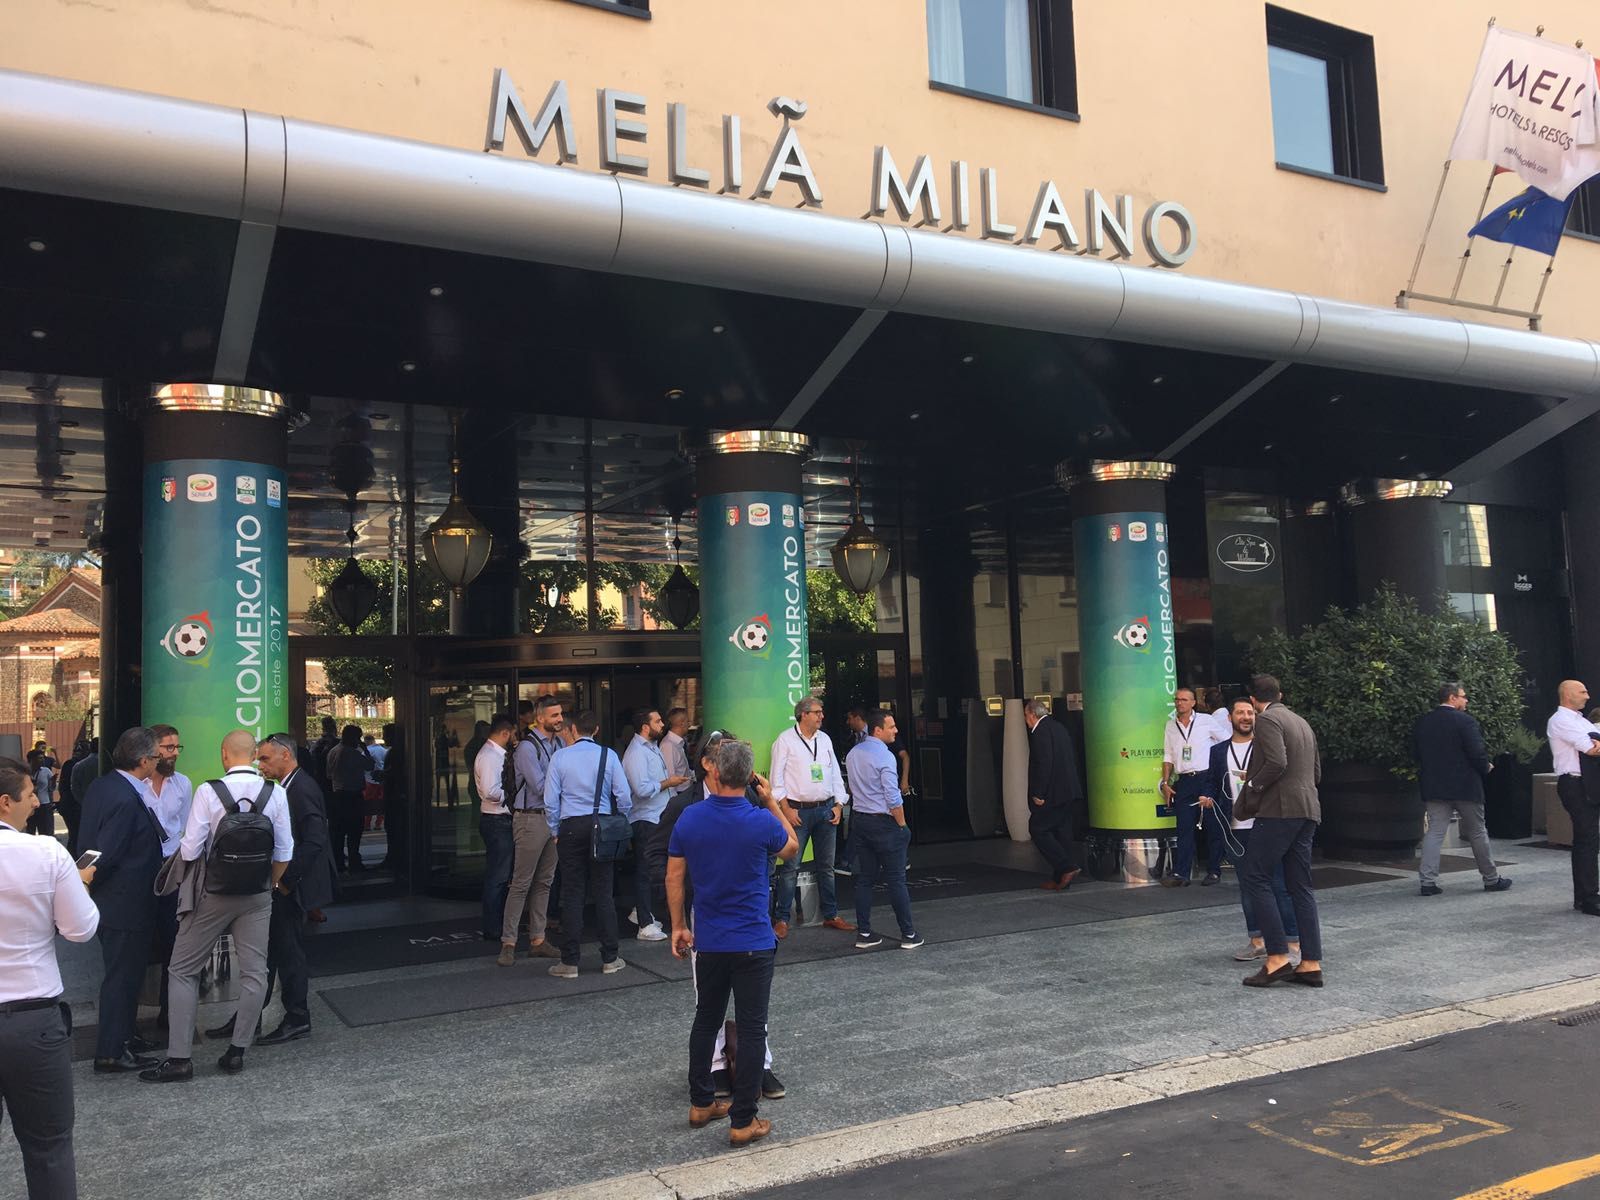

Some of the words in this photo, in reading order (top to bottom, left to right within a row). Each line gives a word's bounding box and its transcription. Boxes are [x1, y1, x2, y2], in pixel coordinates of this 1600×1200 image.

[870, 144, 1197, 268] MILANO
[271, 605, 281, 652] 2017
[273, 660, 281, 707] estate
[1130, 749, 1144, 757] PLAY
